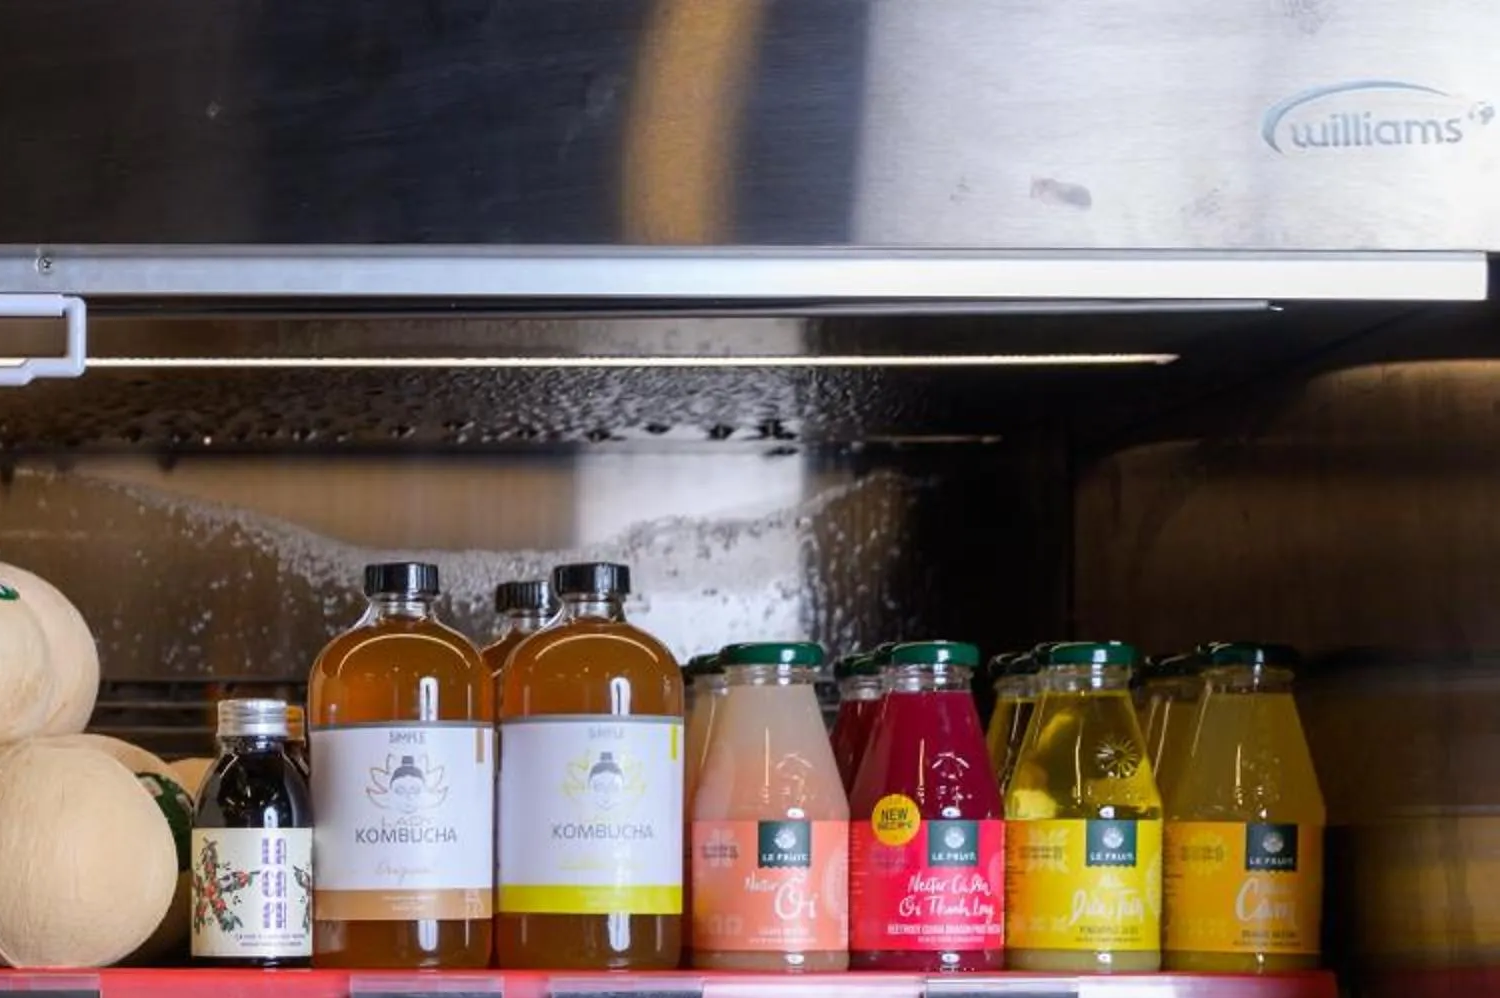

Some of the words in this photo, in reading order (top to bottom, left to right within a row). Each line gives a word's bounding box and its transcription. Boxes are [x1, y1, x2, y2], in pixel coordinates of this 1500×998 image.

[1291, 112, 1463, 147] williams
[881, 806, 910, 820] NEW
[355, 827, 458, 845] KOMBUCHA
[551, 823, 655, 840] KOMBUCHA
